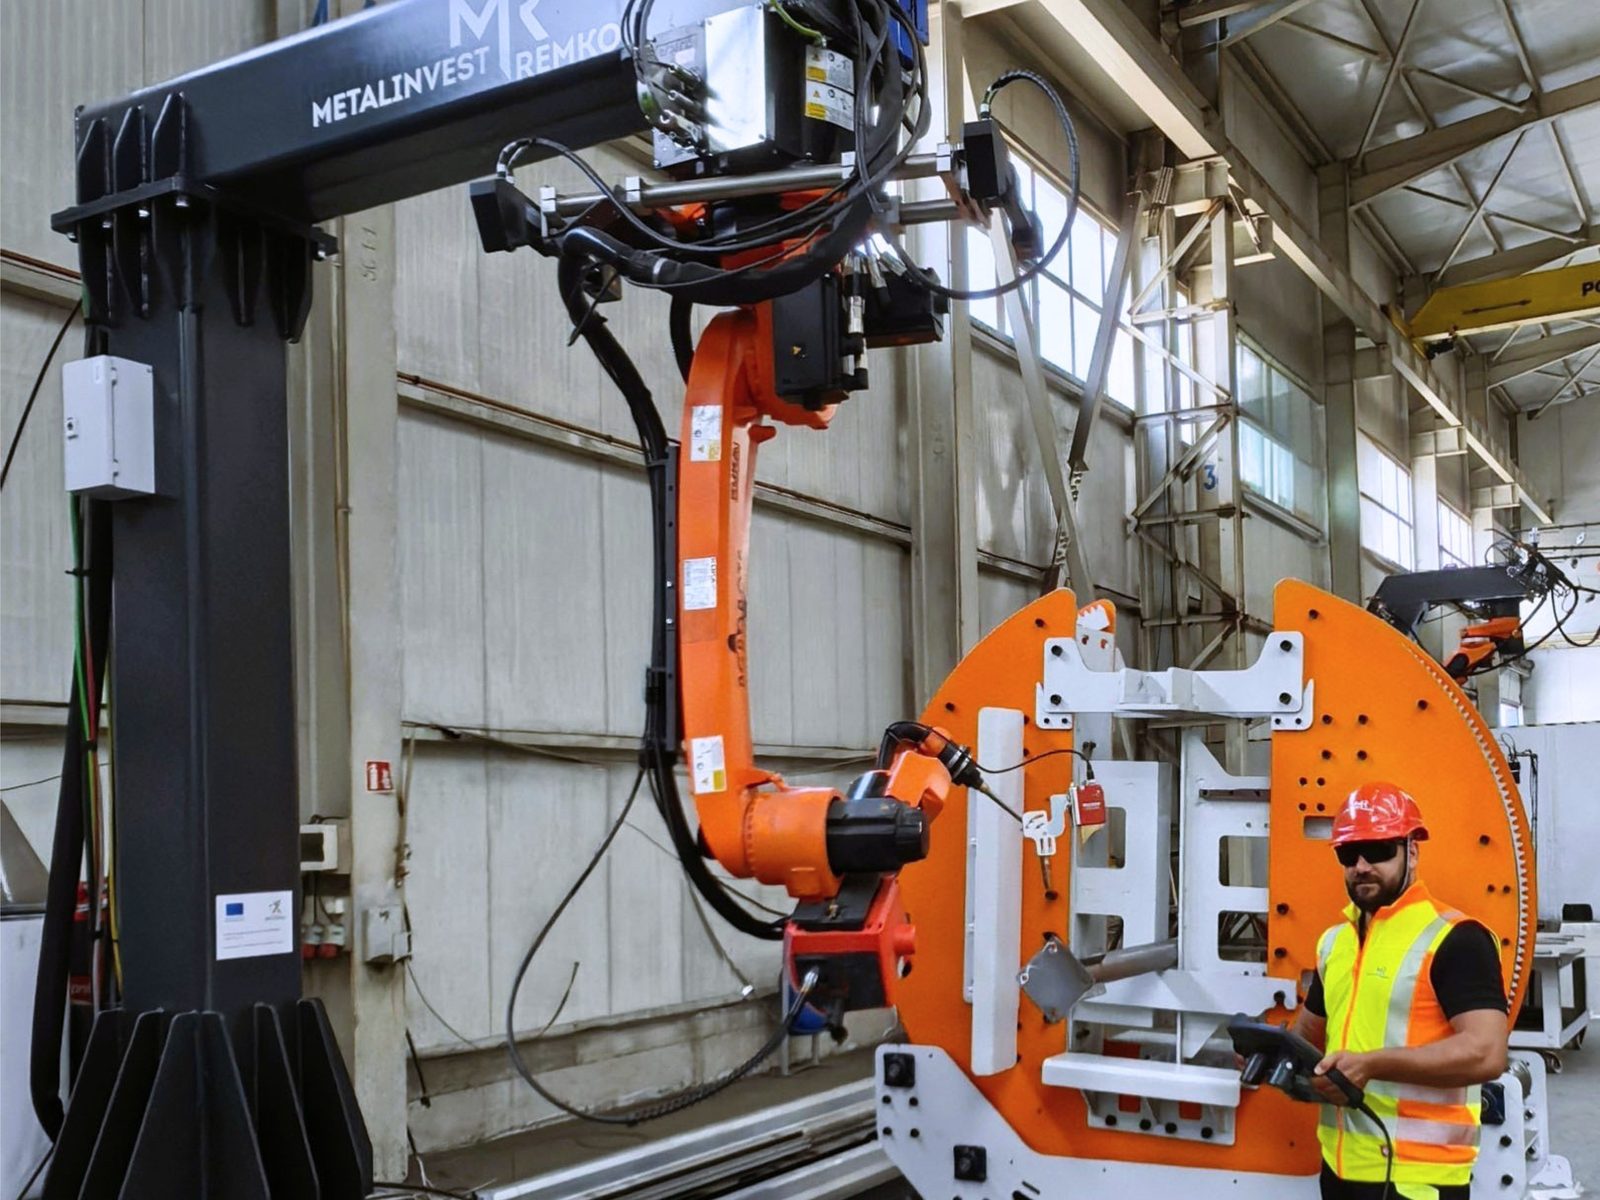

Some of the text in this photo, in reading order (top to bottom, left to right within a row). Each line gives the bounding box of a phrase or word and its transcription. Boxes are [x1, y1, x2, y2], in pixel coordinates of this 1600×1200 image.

[312, 22, 621, 127] METALINVEST REMKO
[1203, 464, 1216, 490] 3
